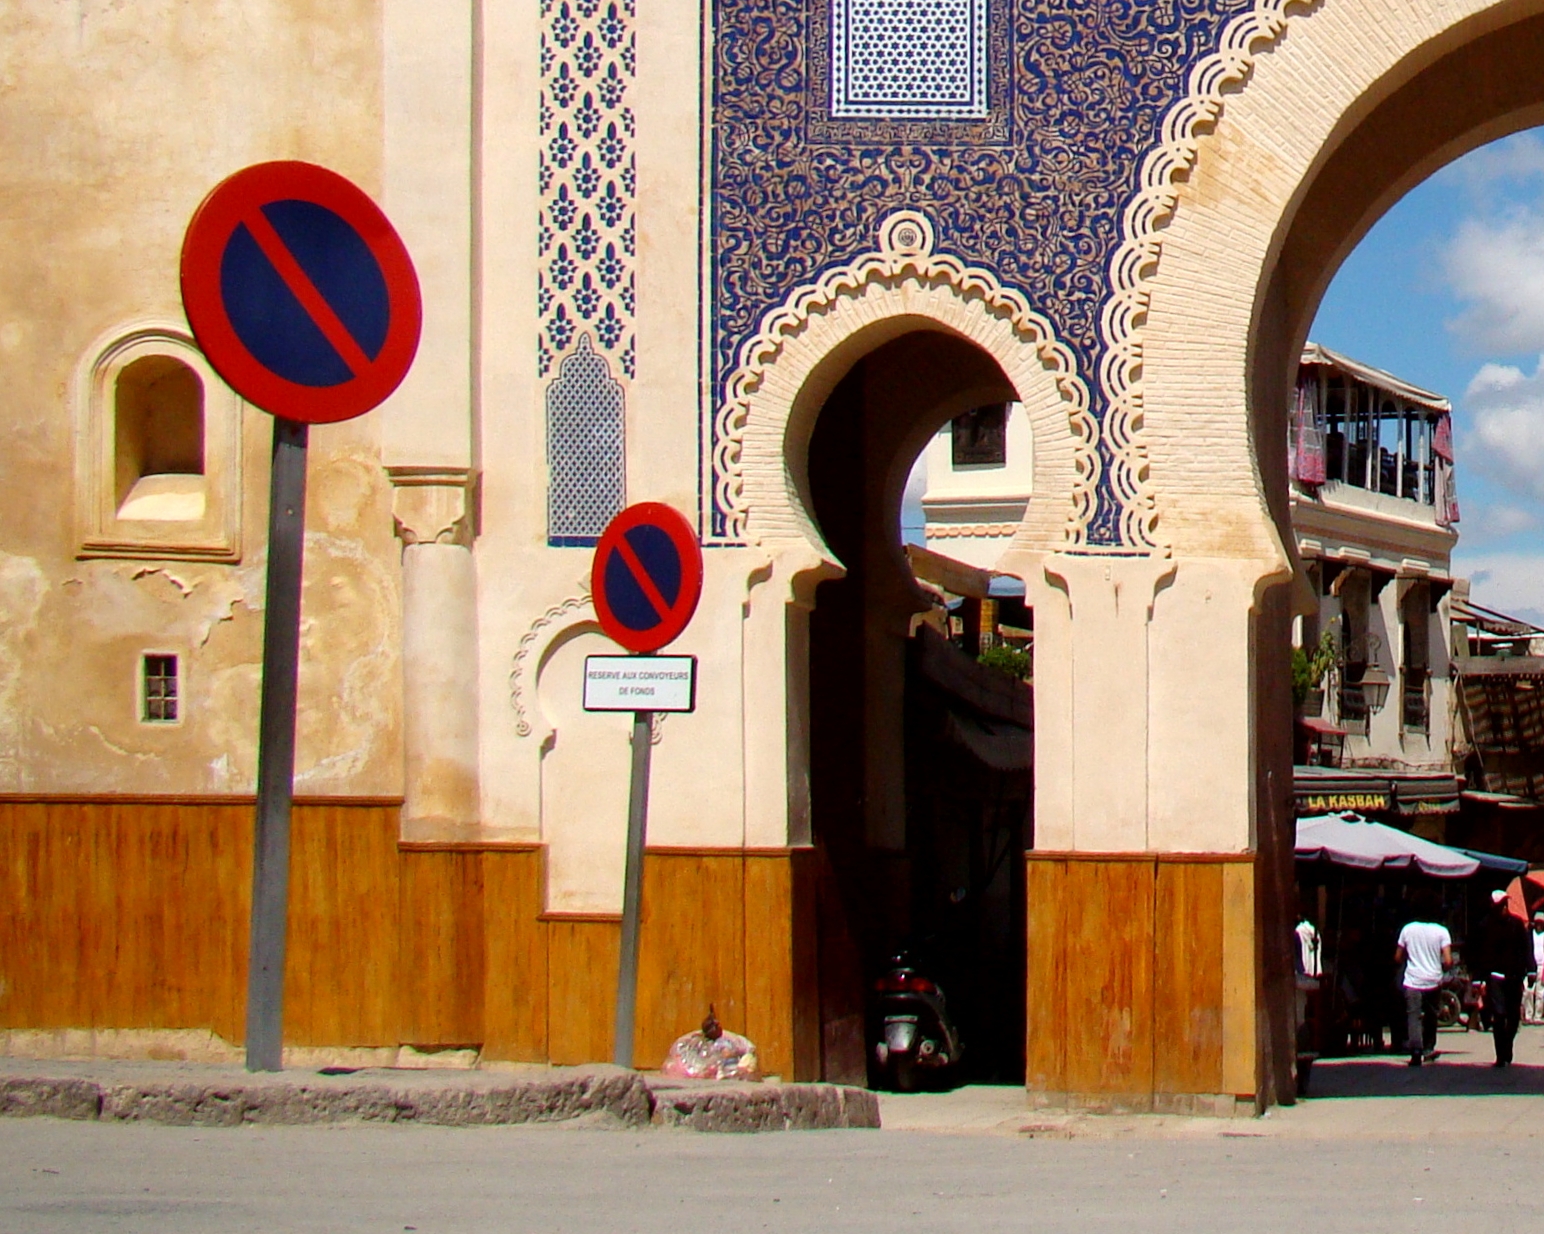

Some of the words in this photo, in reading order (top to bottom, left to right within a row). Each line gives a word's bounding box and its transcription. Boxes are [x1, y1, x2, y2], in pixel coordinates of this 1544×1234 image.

[588, 671, 620, 680] RESERVE
[622, 671, 637, 680] AUX
[638, 671, 689, 680] CONVOYEURS
[619, 687, 629, 695] DE
[630, 687, 656, 696] FONDS
[1308, 795, 1326, 808] LA
[1329, 794, 1386, 809] KASBAH
